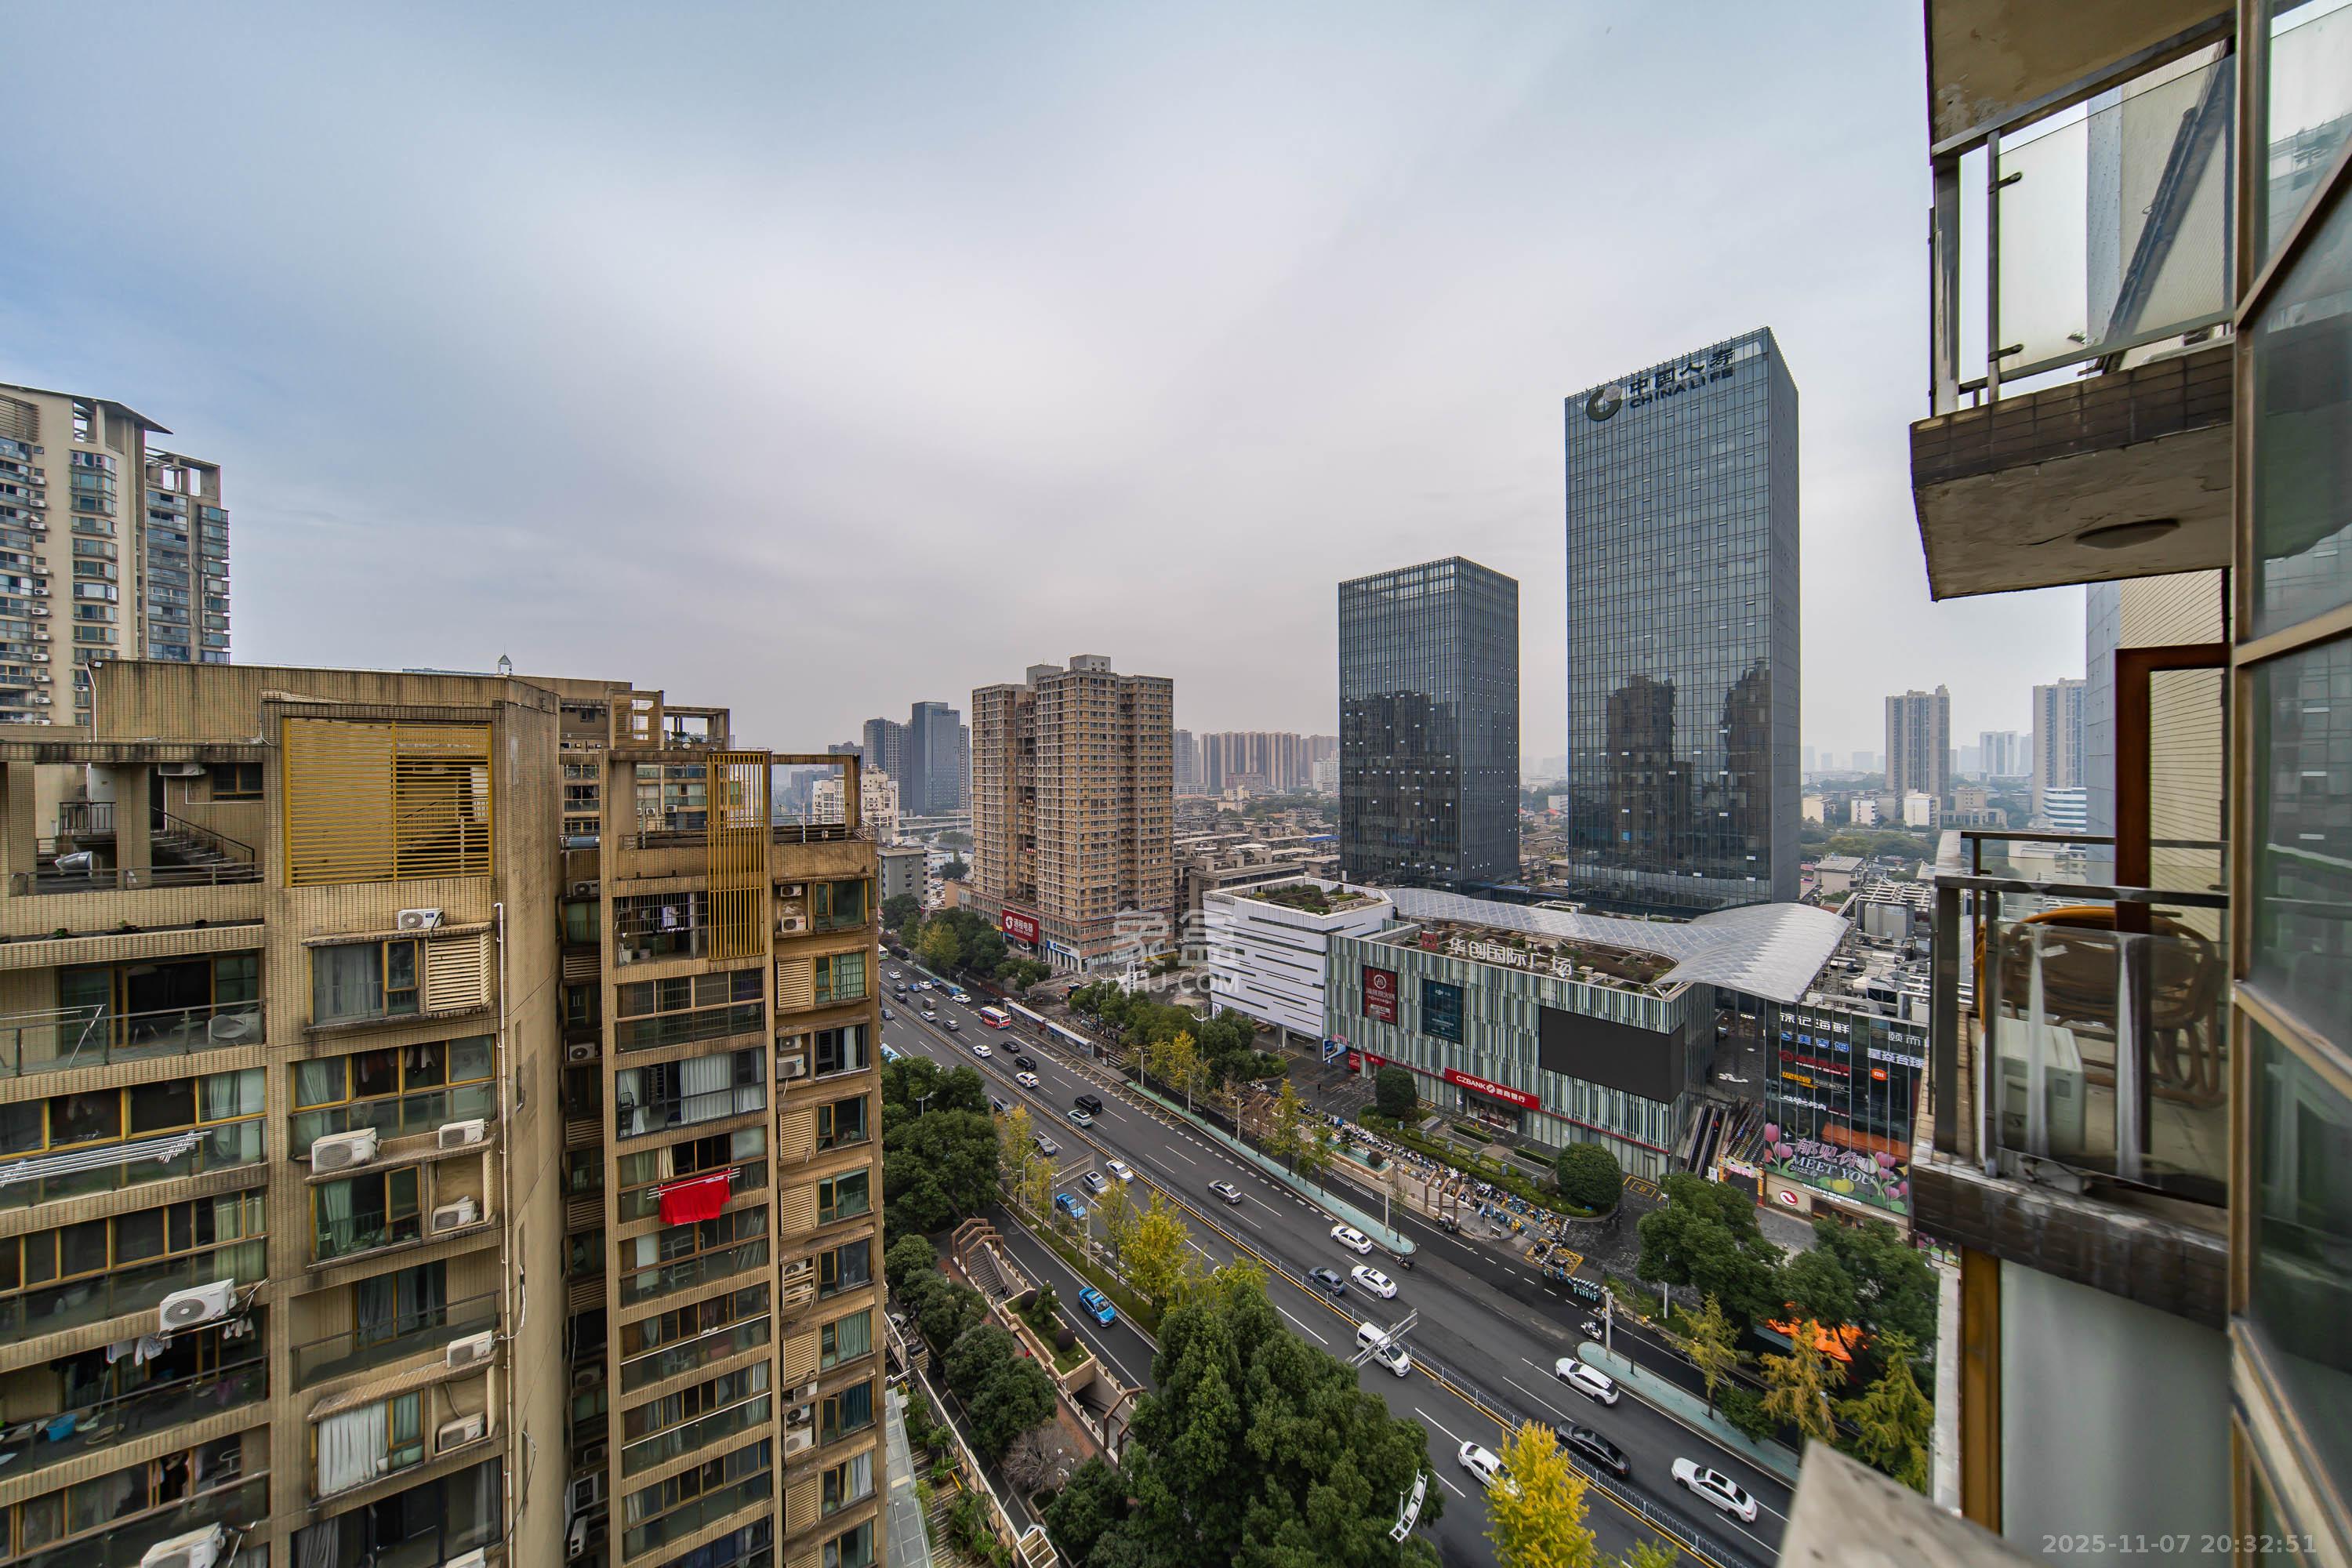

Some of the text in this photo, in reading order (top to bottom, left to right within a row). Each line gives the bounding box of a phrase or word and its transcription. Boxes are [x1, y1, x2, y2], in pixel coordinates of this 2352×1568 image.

[1629, 348, 1735, 395] 中国人寿
[1630, 366, 1734, 408] CHINA LIFE
[1446, 938, 1573, 978] 华创国际广场
[1780, 1012, 1850, 1034] 徐记海鲜
[1888, 1031, 1929, 1048] 颐而
[1456, 1075, 1486, 1091] CZBANK
[1792, 1155, 1877, 1185] MEET YOU
